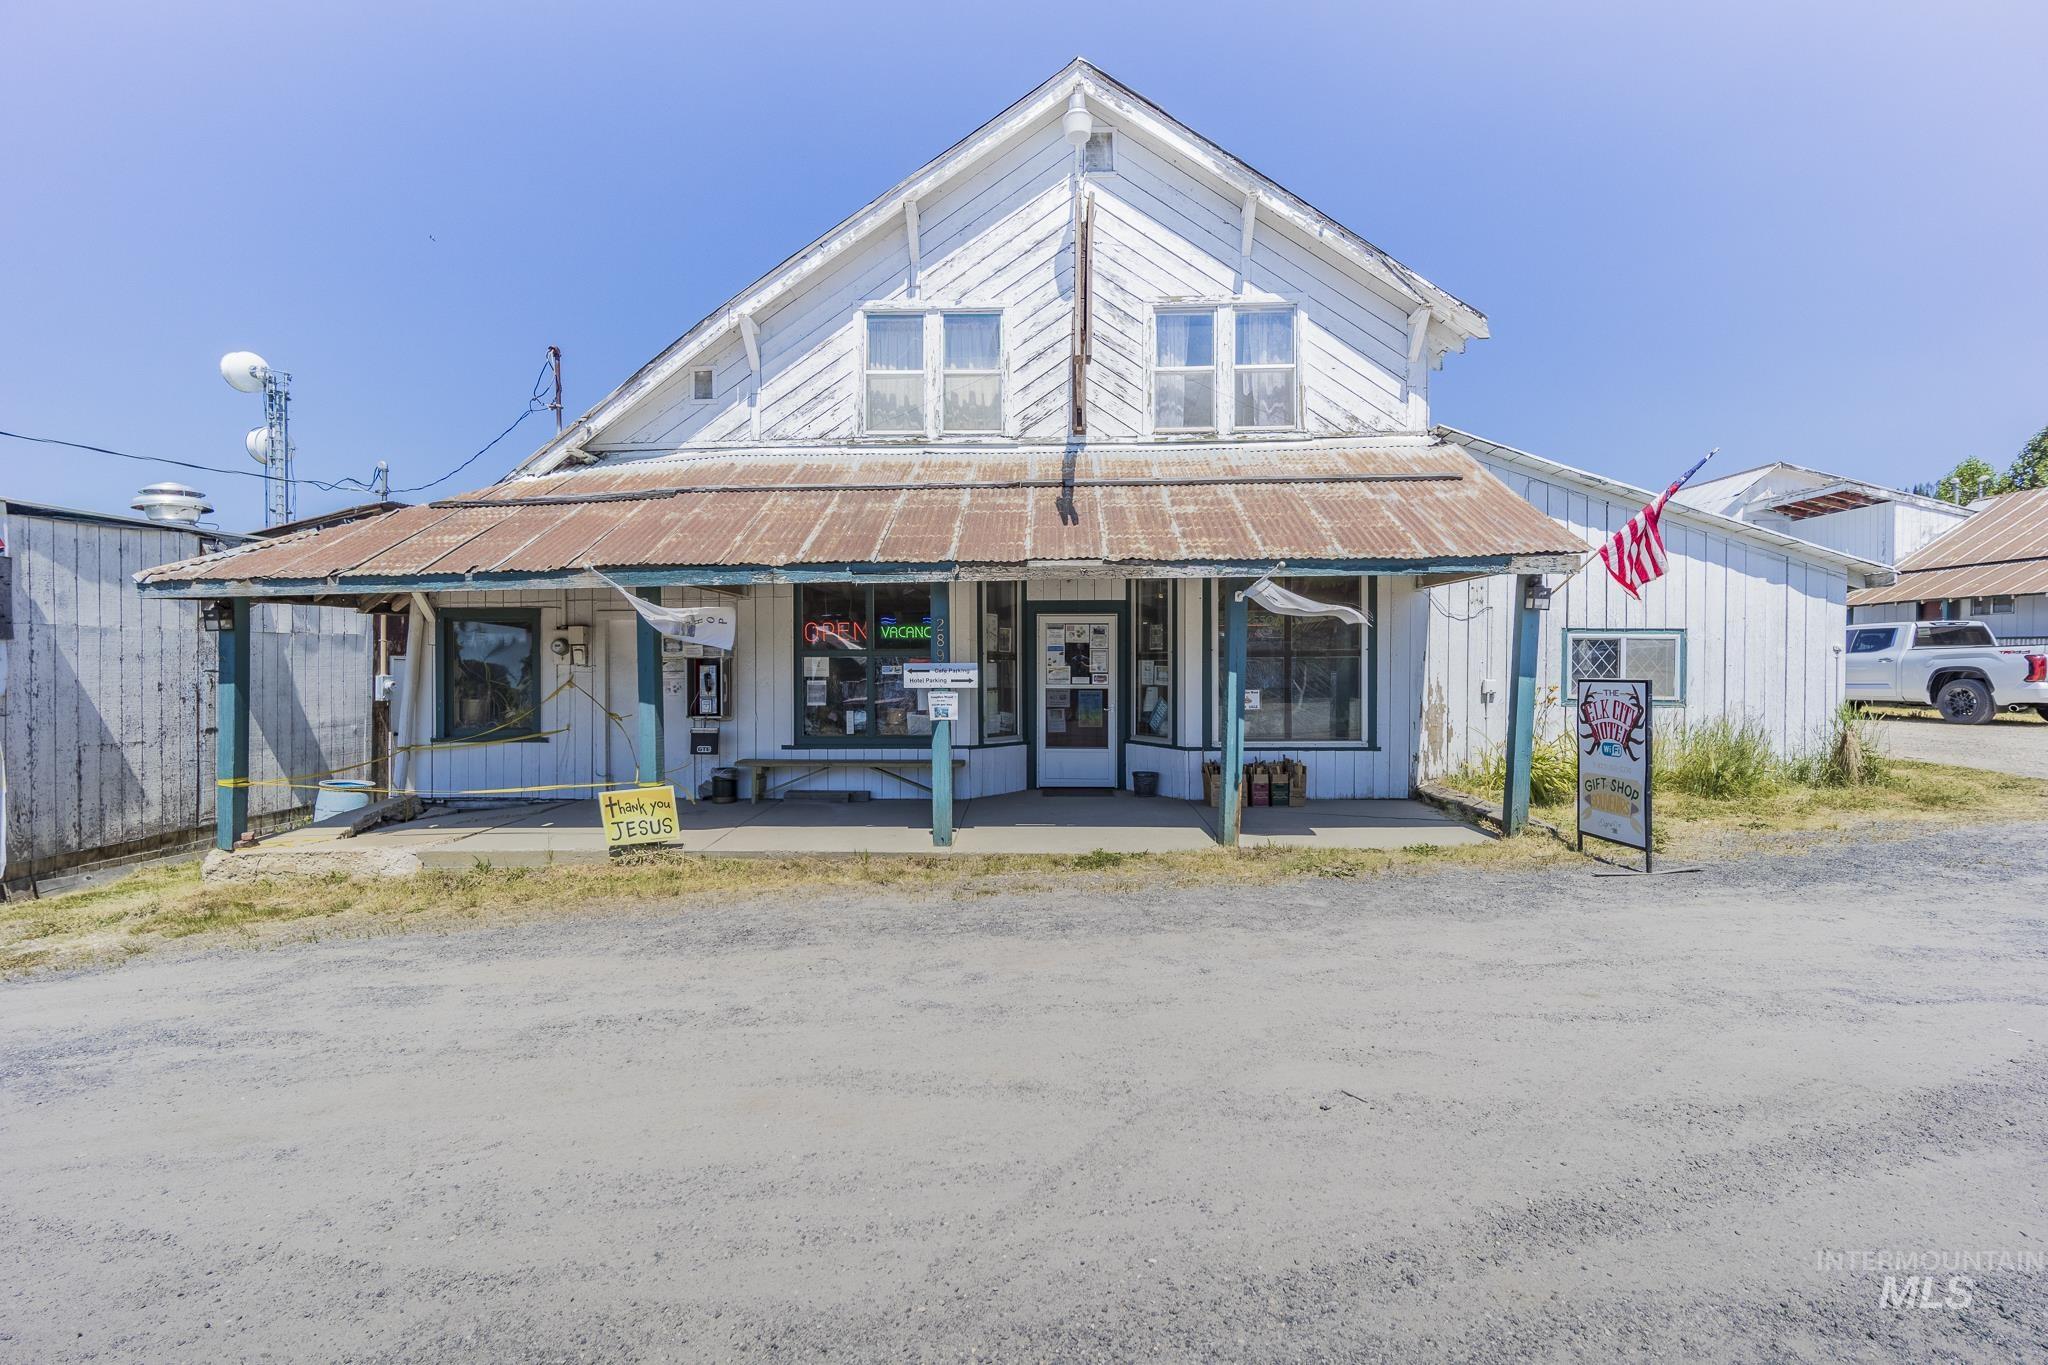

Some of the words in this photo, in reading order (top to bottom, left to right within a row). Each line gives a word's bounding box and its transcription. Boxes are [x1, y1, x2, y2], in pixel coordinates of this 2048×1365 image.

[804, 621, 867, 642] OPEN
[880, 626, 931, 639] VACANC
[1603, 689, 1620, 697] THE
[1585, 699, 1610, 722] ELK
[1612, 700, 1638, 728] CITY
[1584, 777, 1607, 792] GIFT
[1610, 779, 1640, 801] SHOP
[650, 800, 671, 816] you
[611, 817, 673, 841] JESUS
